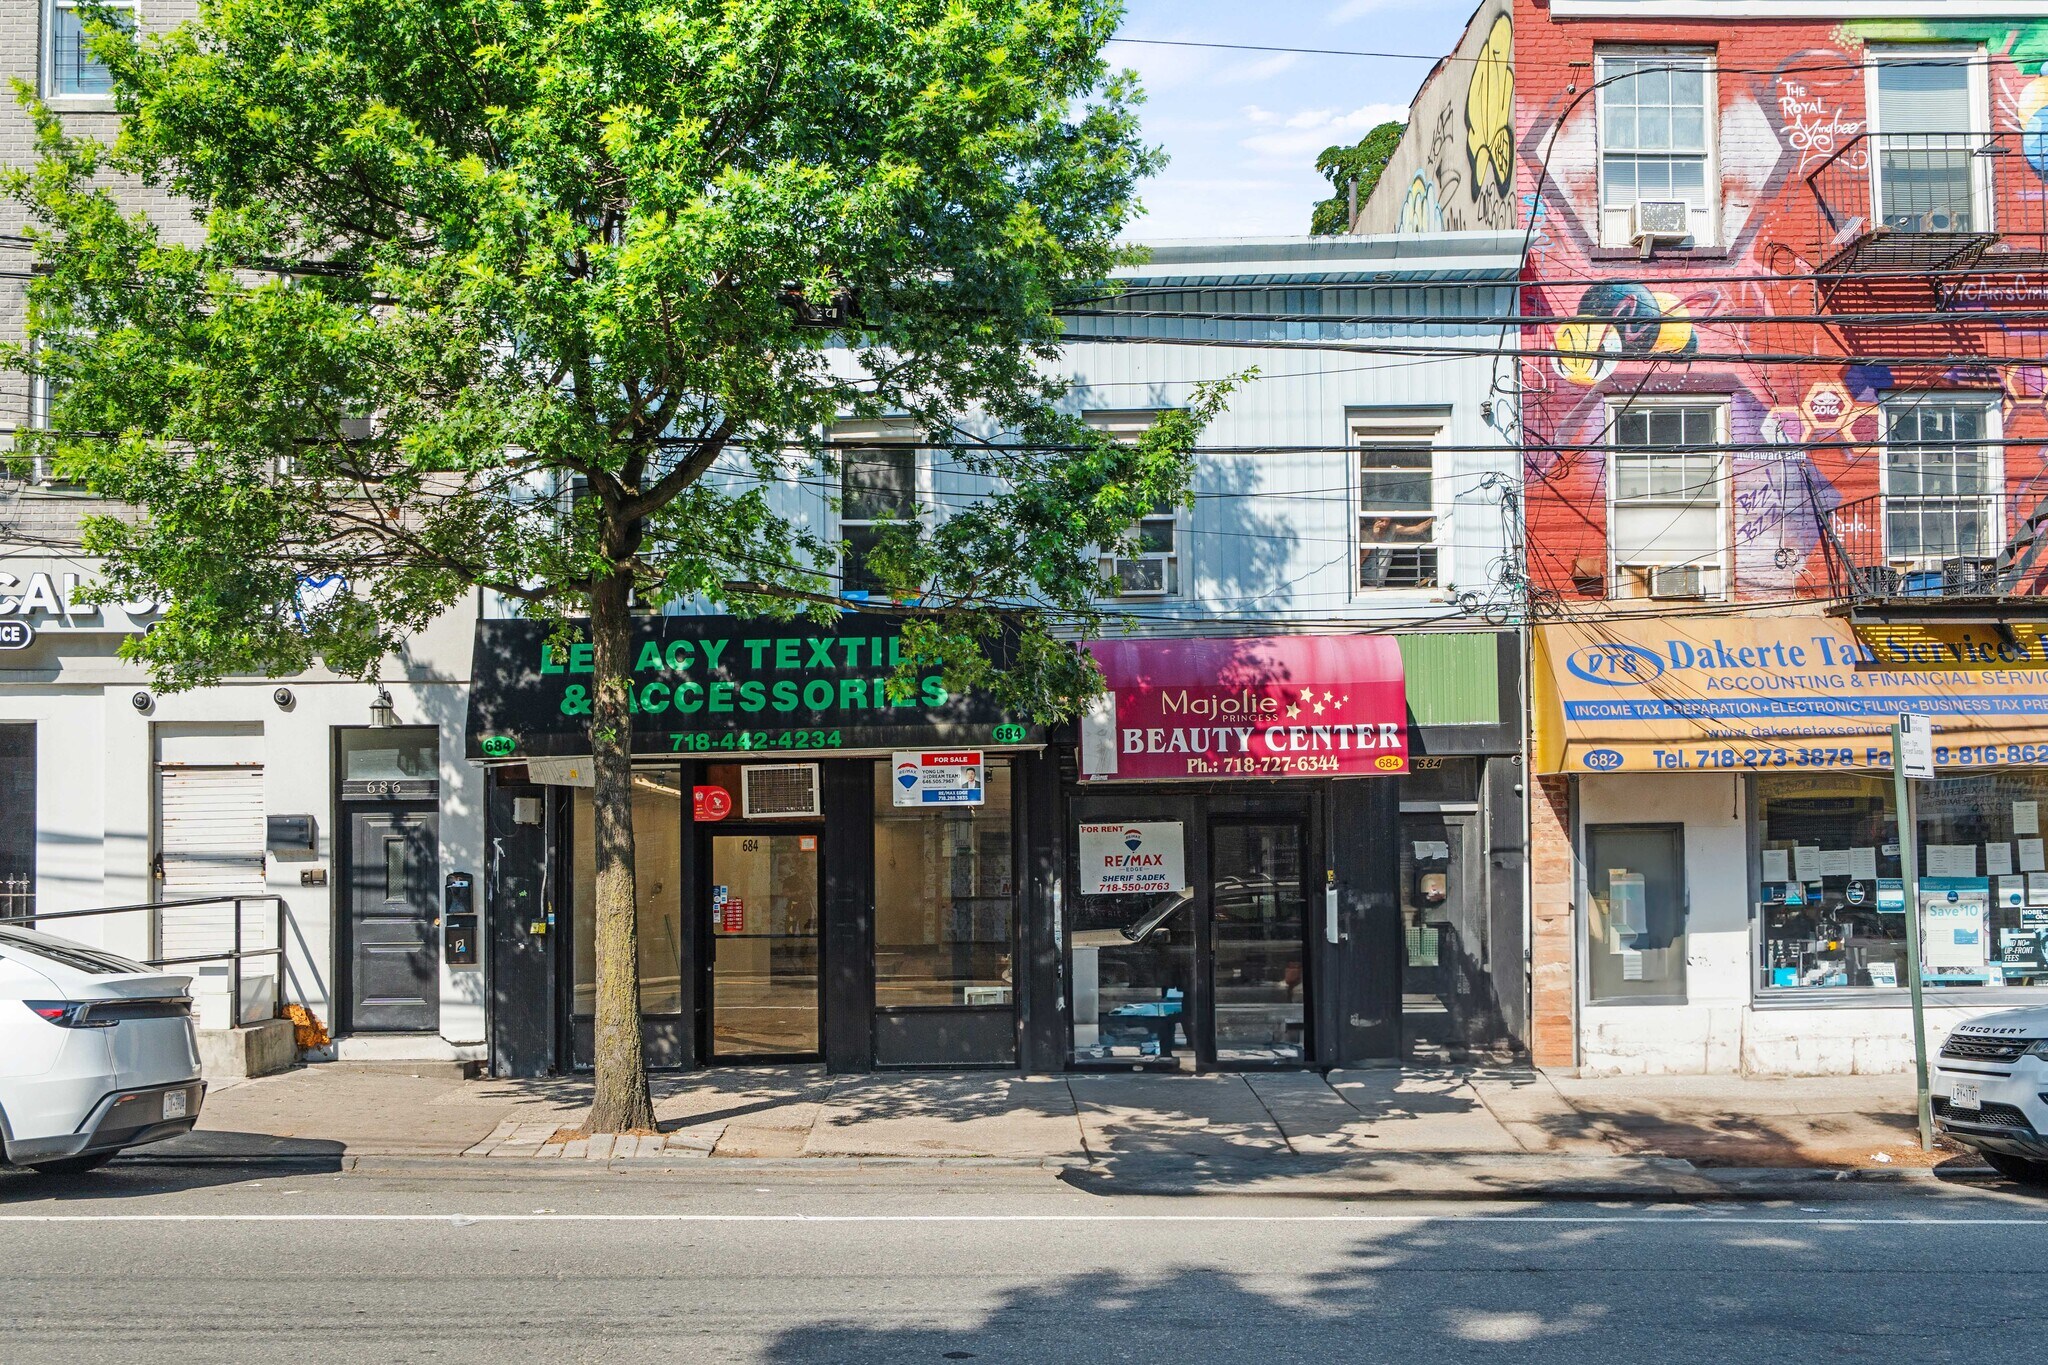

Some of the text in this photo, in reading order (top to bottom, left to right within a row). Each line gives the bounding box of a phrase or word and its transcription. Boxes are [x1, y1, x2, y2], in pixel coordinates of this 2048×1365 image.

[1778, 96, 1829, 118] ROYAL
[540, 636, 974, 674] LEACY TEXTIL
[1588, 653, 1637, 674] DTS
[1664, 638, 1806, 670] Dakerte
[1811, 636, 1881, 667] Tax
[1885, 634, 2031, 664] Services
[1706, 674, 1845, 691] ACCOUNTING
[1851, 674, 1864, 688] &
[1869, 671, 1977, 687] FINANCIAL
[560, 683, 593, 716] &
[1162, 688, 1278, 722] Majolie
[1575, 704, 1632, 717] INCOME
[1634, 703, 1660, 716] TAX
[1663, 702, 1761, 716] PREPARATION
[1771, 700, 1861, 715] ELECTRONIC
[1864, 699, 1911, 713] FILING
[1920, 699, 1991, 712] BUSINESS
[1992, 698, 2020, 711] TAX
[1222, 713, 1278, 723] PRINCESS
[669, 730, 842, 751] 718-442-4234
[996, 727, 1022, 740] 684
[1122, 722, 1402, 754] BEAUTY CENTER
[485, 740, 511, 752] 684
[1187, 754, 1340, 774] Ph.: 718-727-6344
[1378, 757, 1399, 769] 684
[1418, 759, 1442, 768] 684
[1589, 754, 1618, 767] 682
[1653, 750, 1690, 769] Tel.
[1696, 748, 1853, 768] 718-273-3878
[1867, 747, 1894, 766] Fa
[367, 780, 401, 794] 686
[1101, 825, 1124, 833] RENT
[742, 839, 759, 852] 684
[1104, 854, 1163, 867] RE/MAX
[1102, 873, 1166, 882] SHERIF SADEK
[1099, 882, 1170, 892] 718-550-0763
[1930, 903, 1978, 917] Save $10
[1960, 1025, 2027, 1034] DISCOVERY
